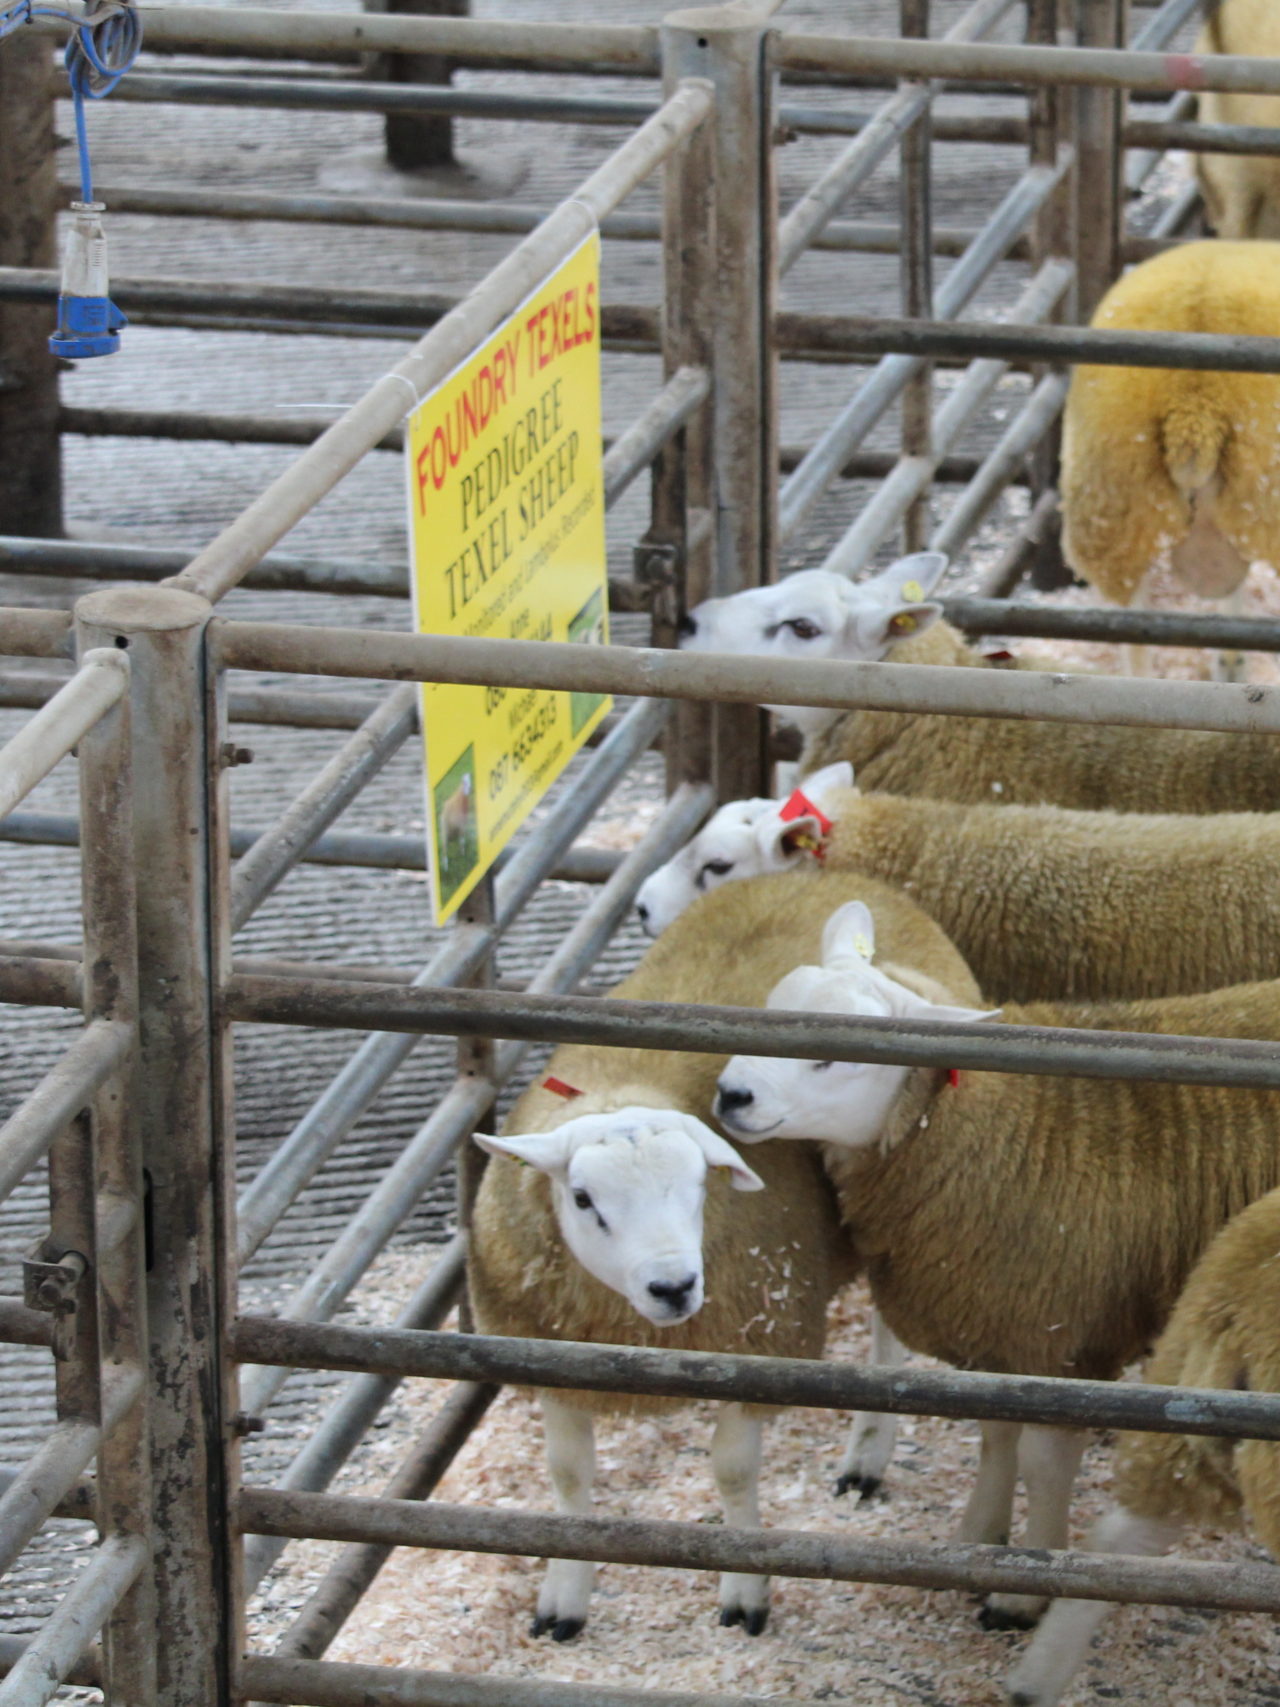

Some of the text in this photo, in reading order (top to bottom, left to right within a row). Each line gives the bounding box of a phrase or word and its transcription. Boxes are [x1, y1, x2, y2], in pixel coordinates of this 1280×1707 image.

[416, 282, 595, 517] FOUNDRY TEXELS
[461, 377, 562, 533] PEDIGREE
[445, 430, 578, 620] TEXEL SHEEP
